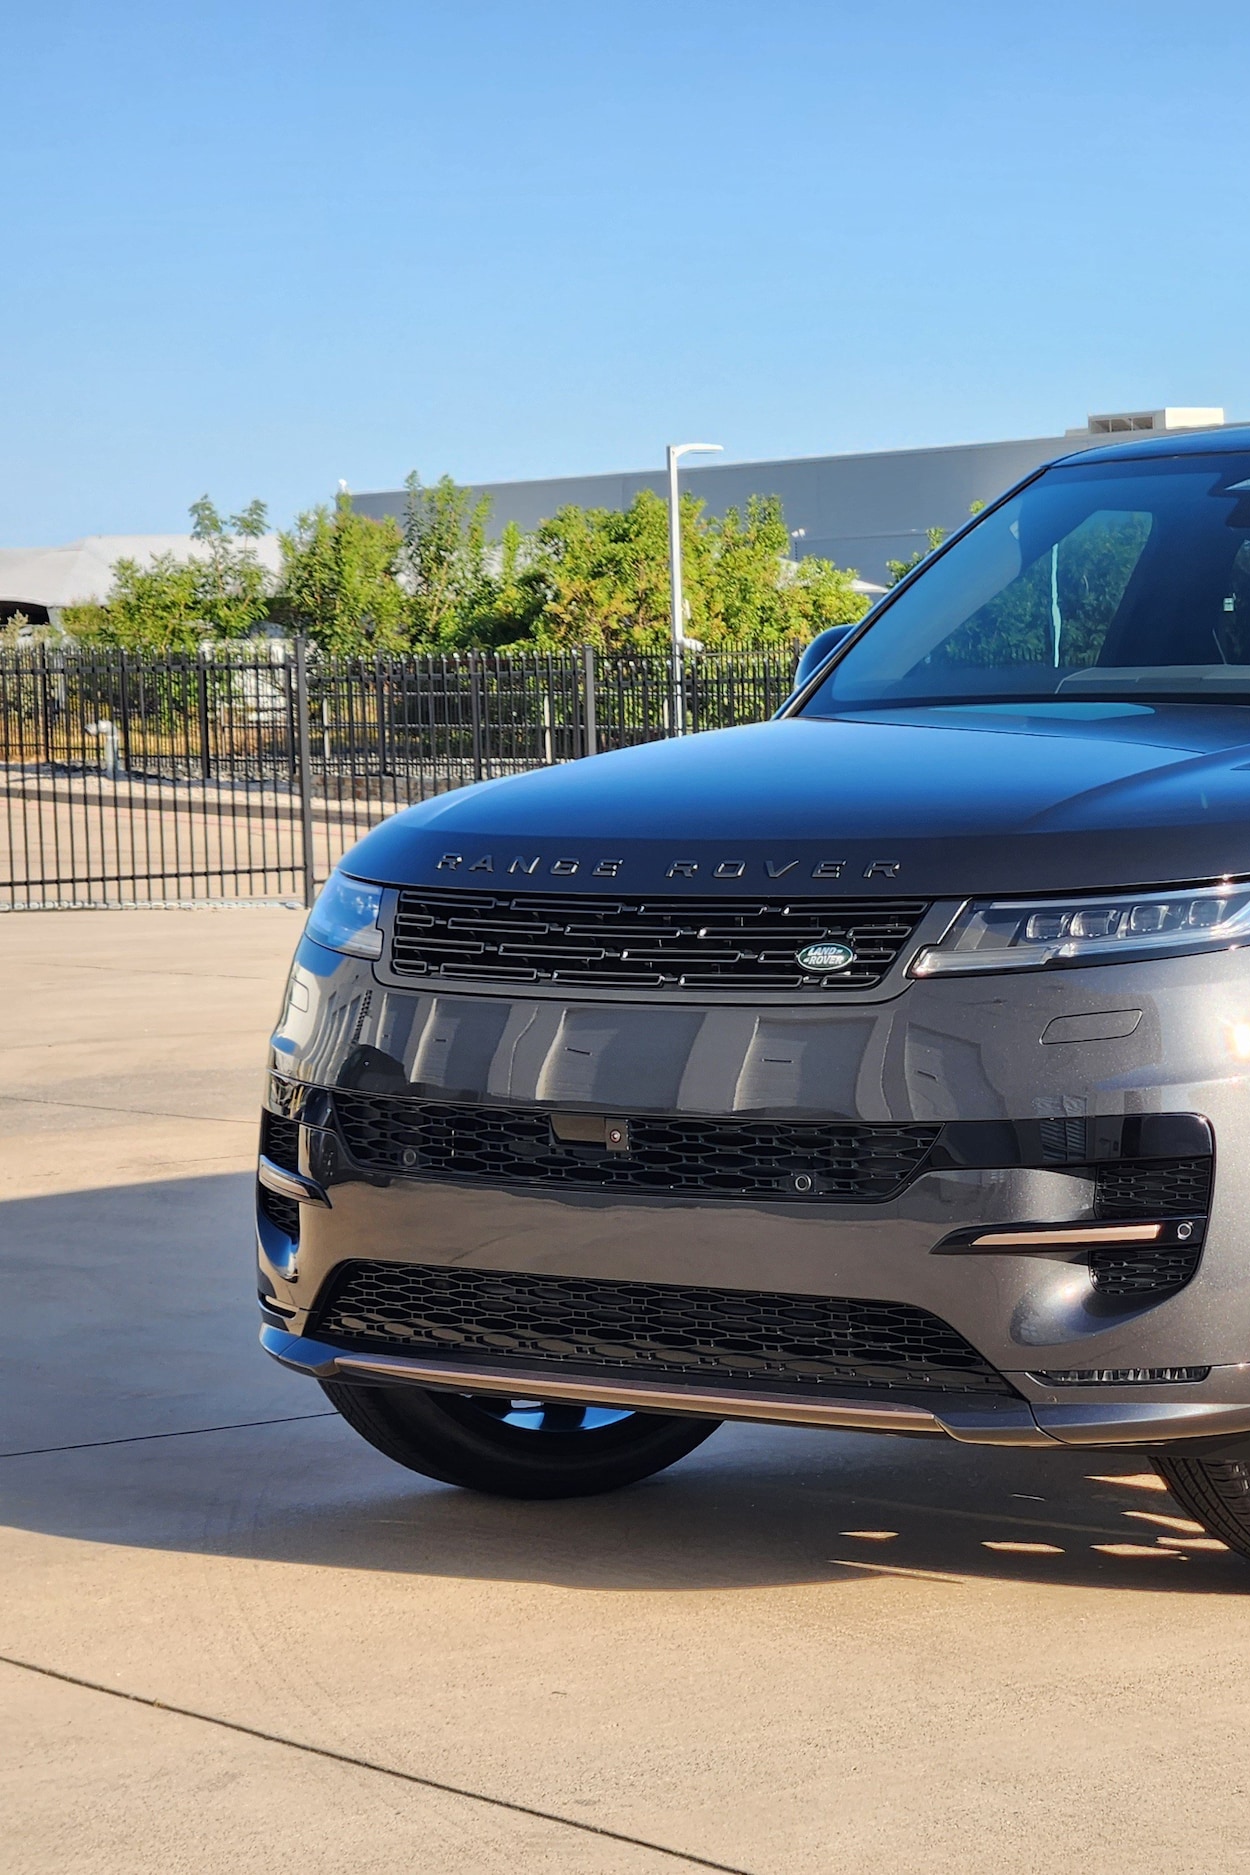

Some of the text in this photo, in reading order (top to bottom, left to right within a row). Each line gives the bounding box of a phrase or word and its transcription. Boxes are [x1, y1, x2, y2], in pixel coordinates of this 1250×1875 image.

[436, 852, 902, 879] RANGE ROVER
[808, 946, 837, 956] LAND
[808, 955, 845, 965] ROVER
